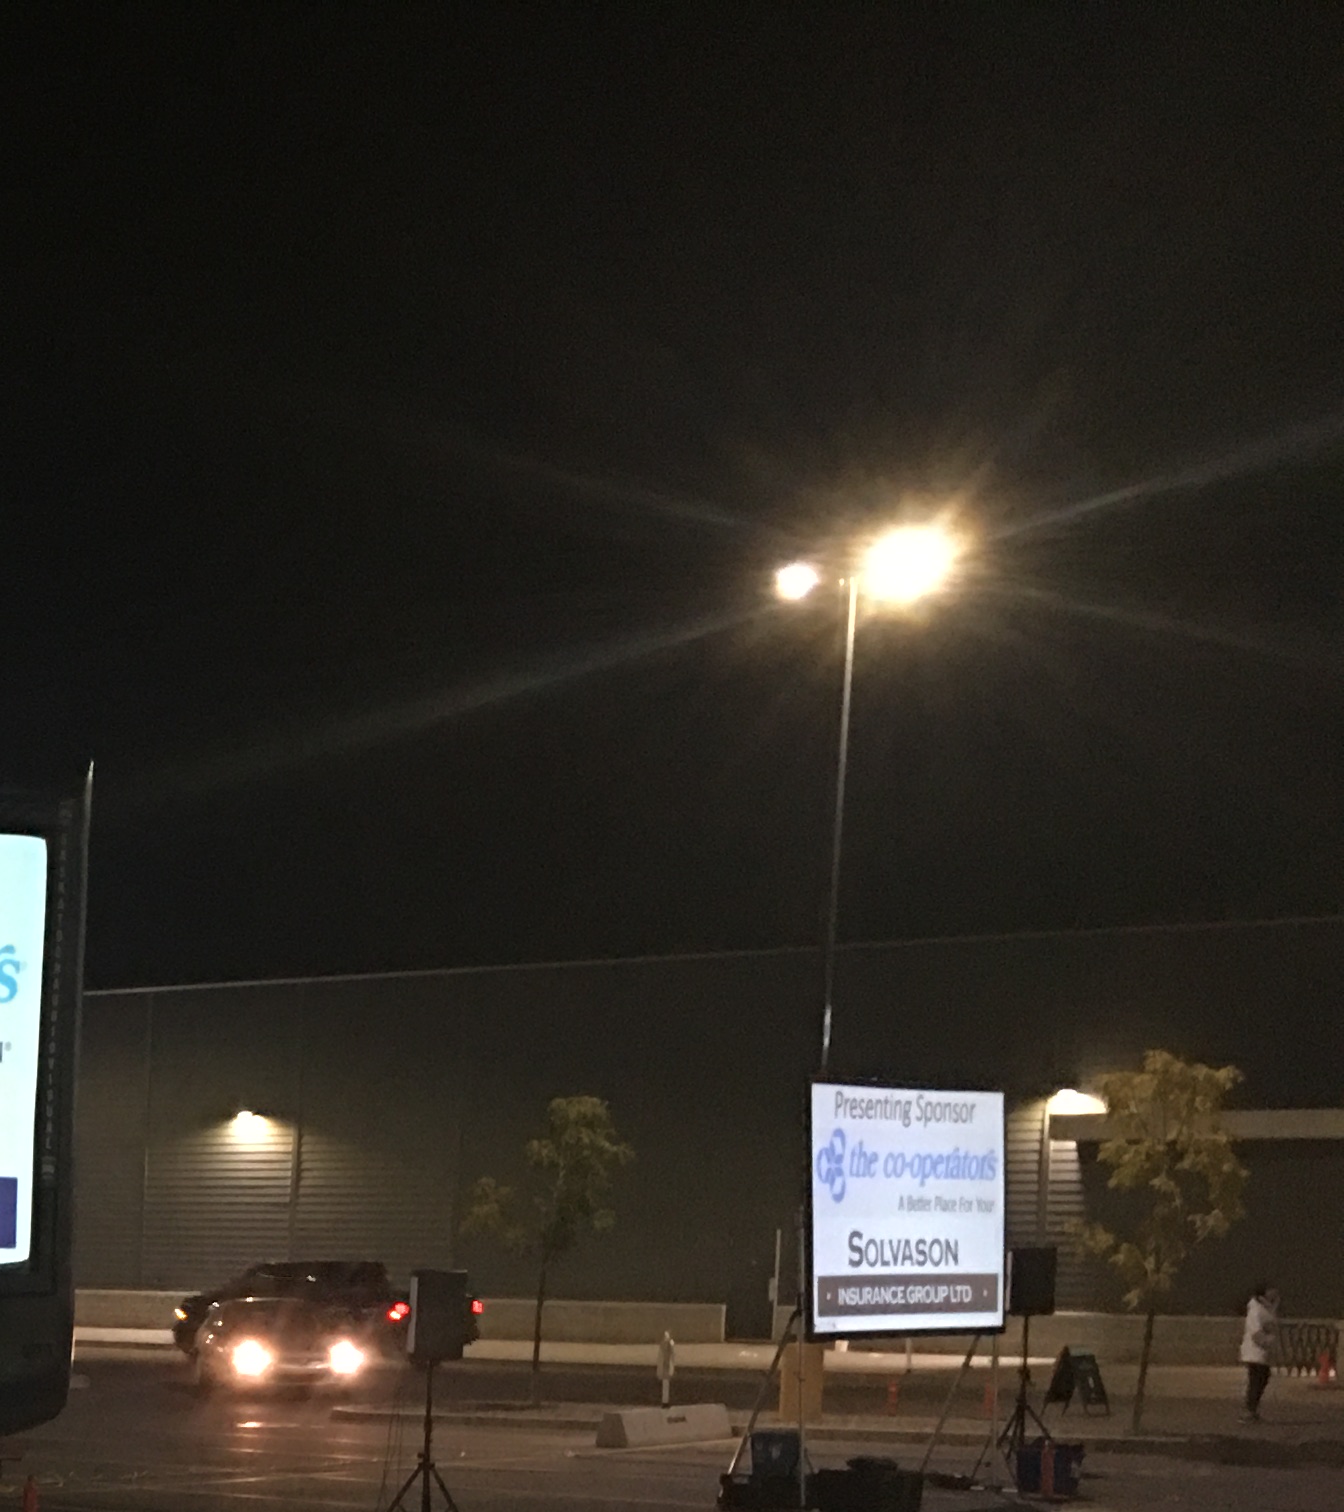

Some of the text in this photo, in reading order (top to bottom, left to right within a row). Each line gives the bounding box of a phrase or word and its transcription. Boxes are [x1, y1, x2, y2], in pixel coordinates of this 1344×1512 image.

[834, 1090, 976, 1128] Presenting Sponsor
[849, 1140, 998, 1187] the co-operators
[848, 1230, 958, 1268] SOLVASON
[838, 1286, 905, 1305] INSURANCE
[906, 1285, 949, 1304] GROUP
